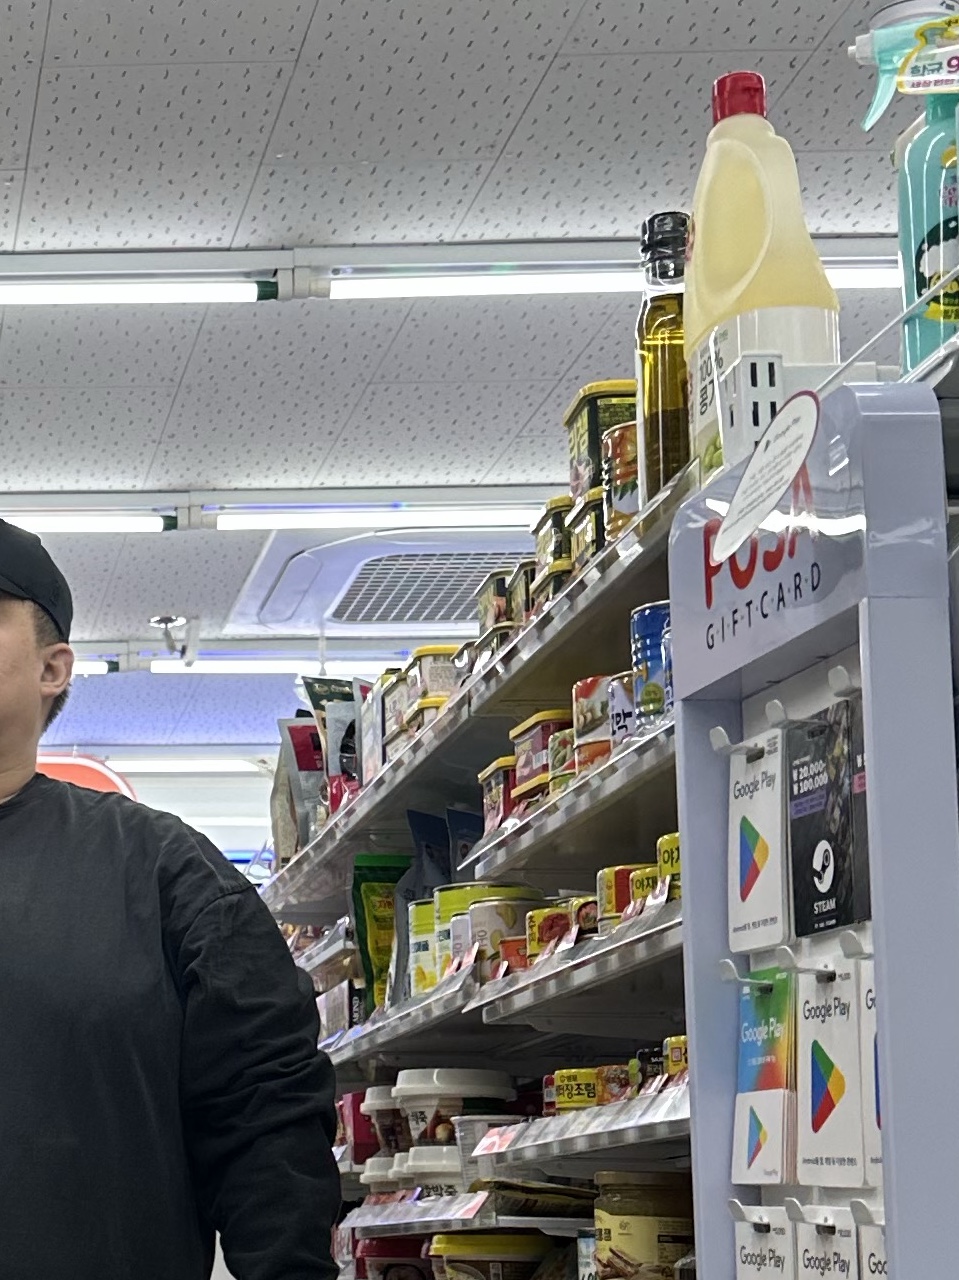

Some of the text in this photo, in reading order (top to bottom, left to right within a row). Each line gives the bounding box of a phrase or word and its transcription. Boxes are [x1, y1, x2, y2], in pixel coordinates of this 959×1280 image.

[733, 769, 777, 800] Google Play
[813, 897, 837, 915] STEAM
[802, 1000, 833, 1024] Google
[833, 996, 851, 1021] Play
[741, 1020, 769, 1047] Google
[739, 1244, 786, 1275] Google Play
[802, 1248, 851, 1280] Google Play
